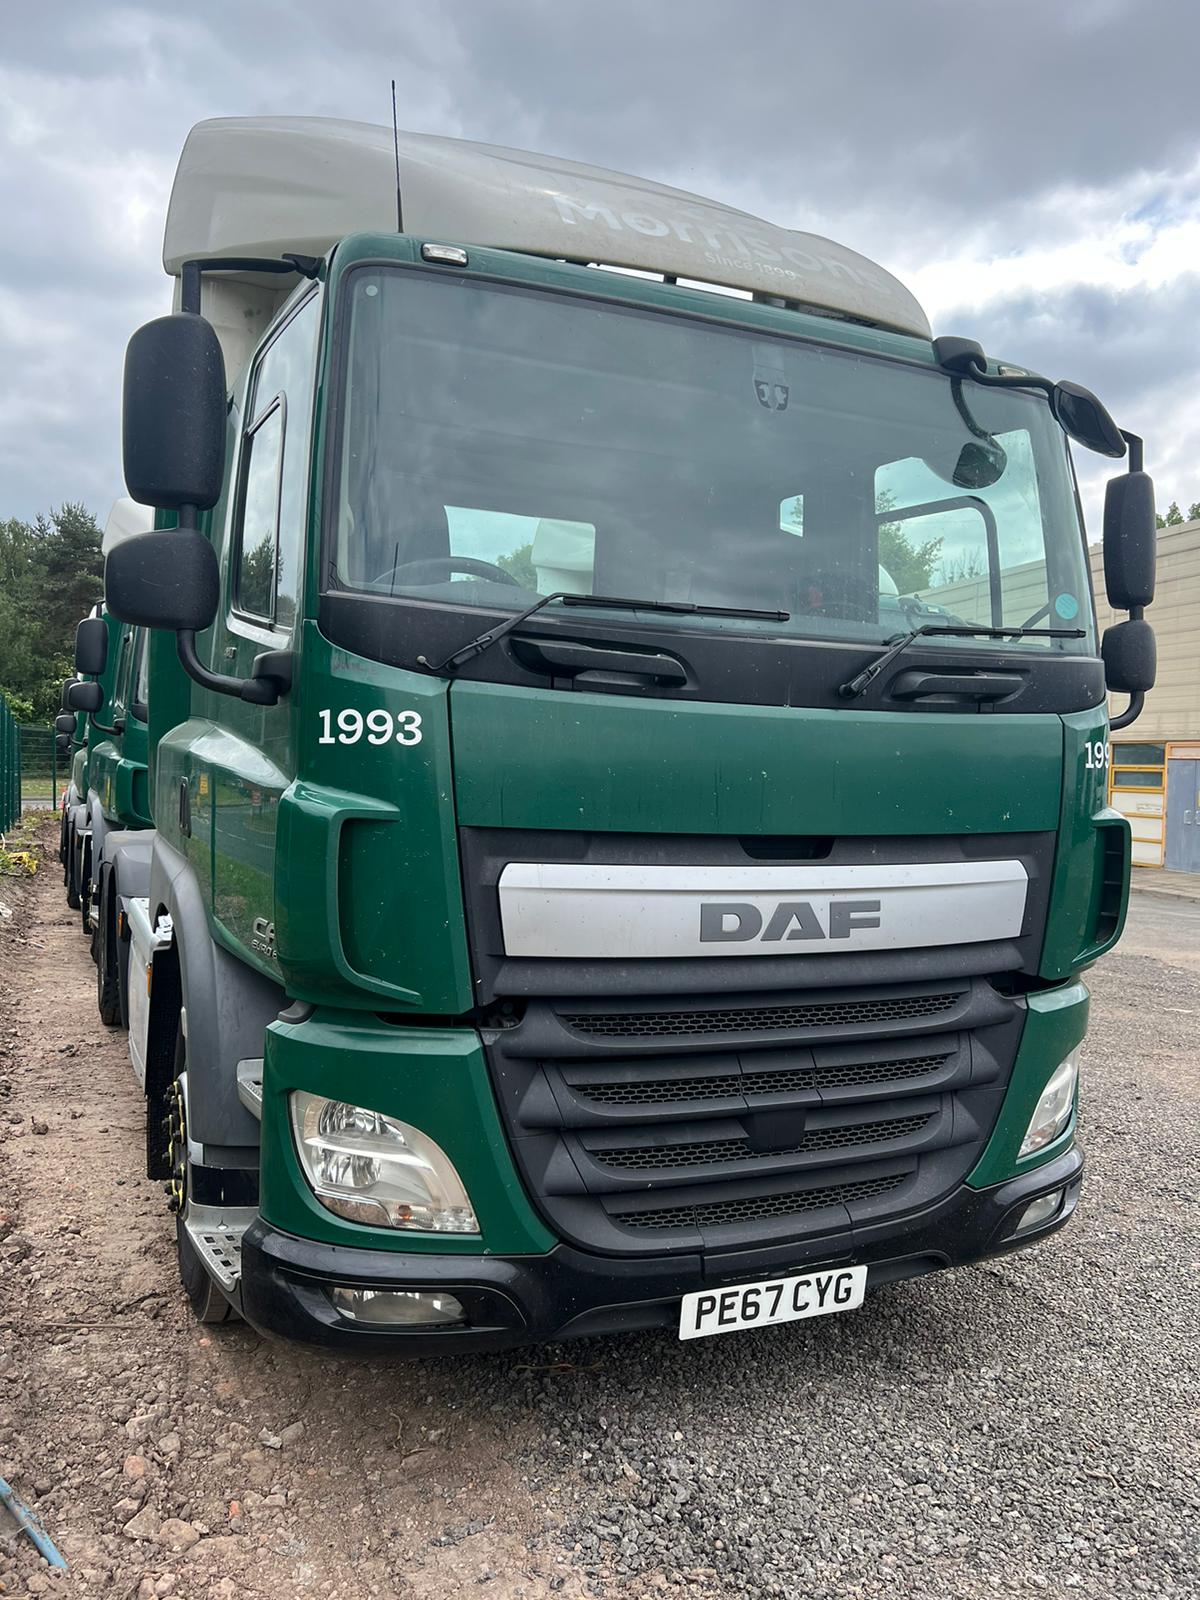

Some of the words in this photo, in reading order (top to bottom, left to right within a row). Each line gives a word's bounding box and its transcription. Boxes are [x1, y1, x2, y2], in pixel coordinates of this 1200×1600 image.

[550, 195, 893, 293] Morrisons
[703, 252, 753, 271] Since
[318, 708, 423, 746] 1993
[699, 899, 881, 943] DAF
[695, 1284, 784, 1329] PE67
[792, 1272, 853, 1312] CYG
